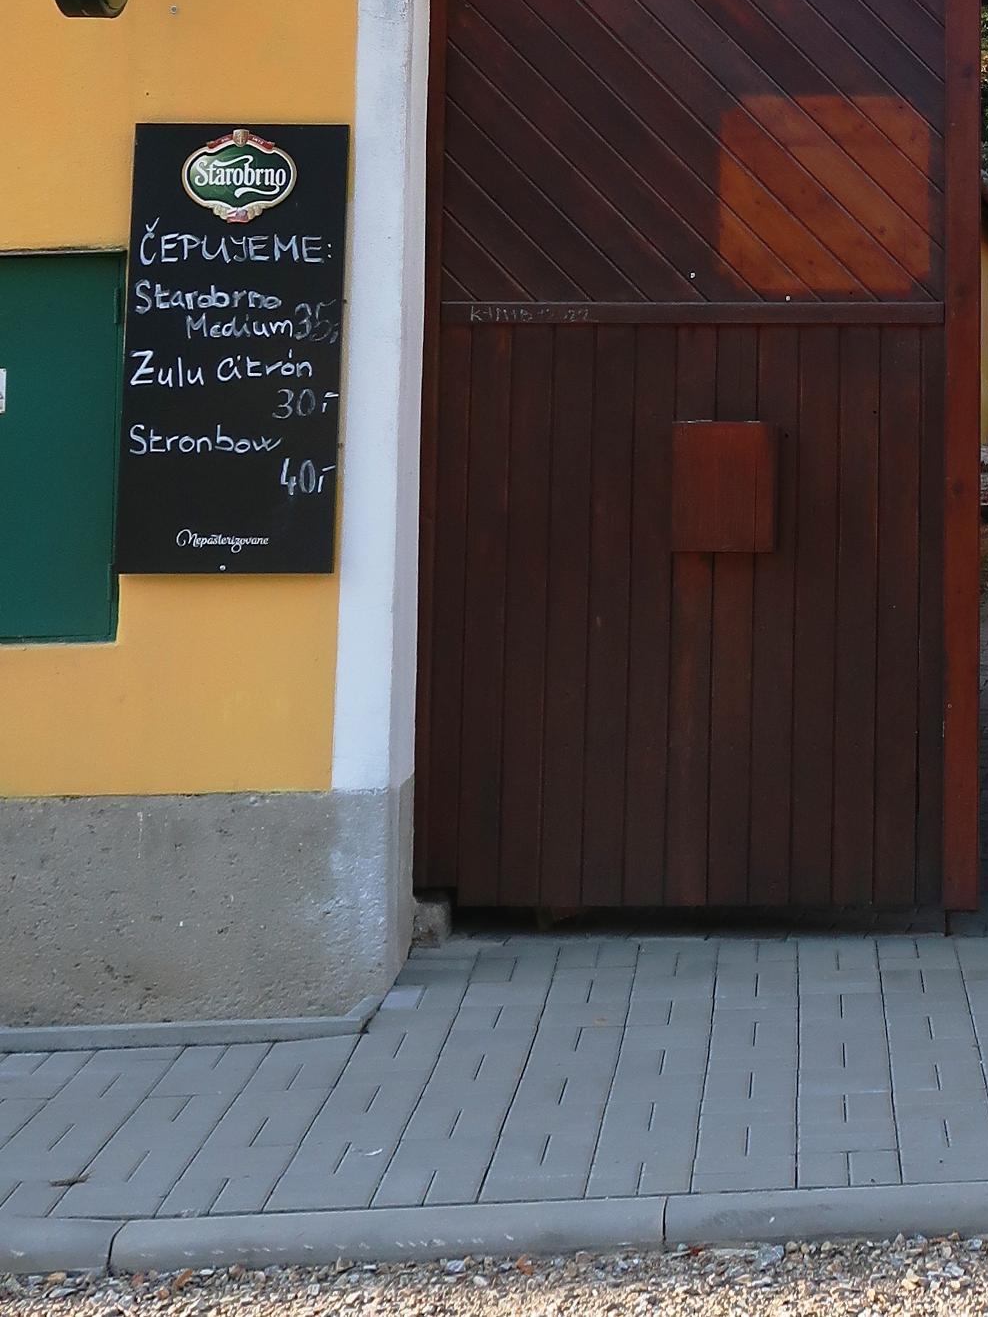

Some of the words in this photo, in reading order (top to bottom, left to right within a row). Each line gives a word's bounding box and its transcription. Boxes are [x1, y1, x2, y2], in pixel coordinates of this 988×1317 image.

[194, 155, 287, 198] Starobrno
[139, 217, 333, 267] ČEPUJEME:
[134, 279, 282, 314] Starobrno
[185, 312, 294, 340] Medium
[130, 350, 205, 388] Zulu
[216, 348, 314, 382] Citrón
[129, 424, 282, 456] Stronbow
